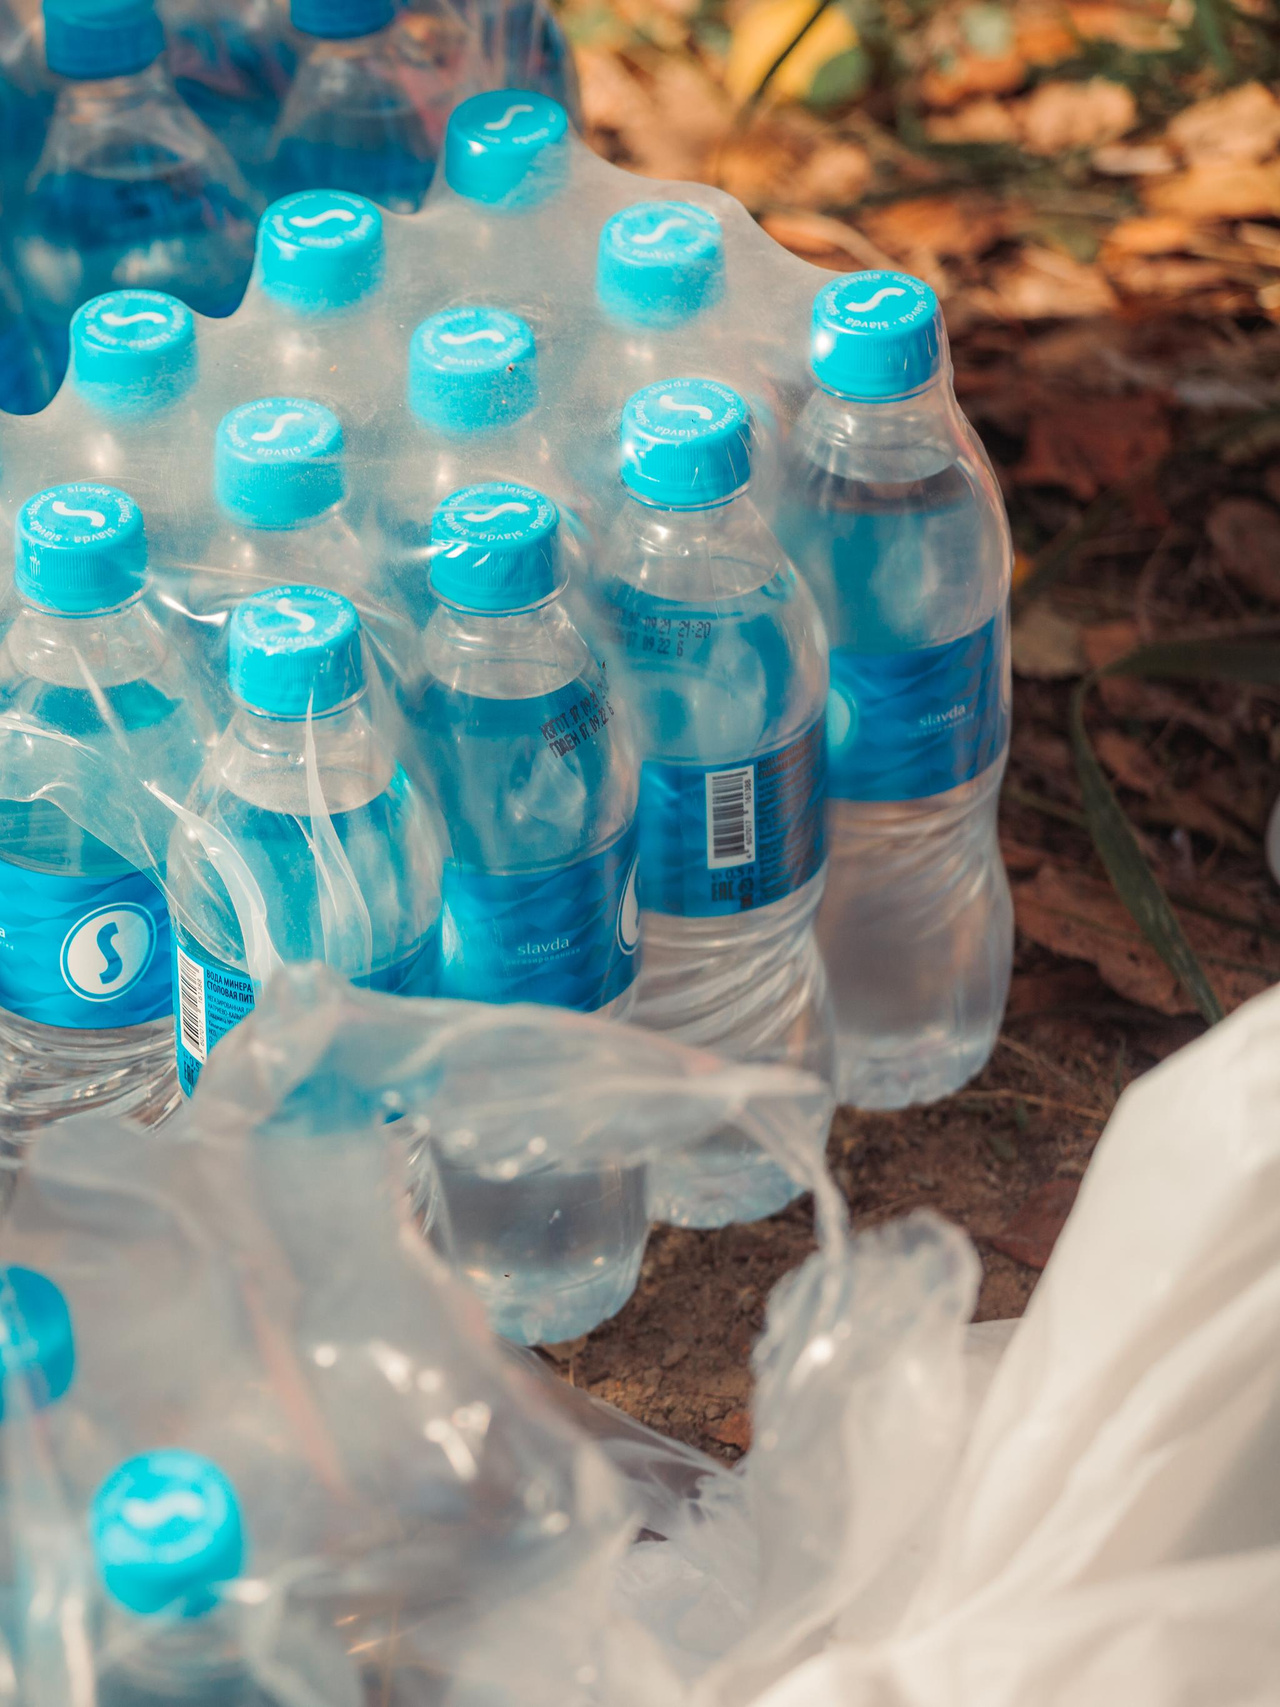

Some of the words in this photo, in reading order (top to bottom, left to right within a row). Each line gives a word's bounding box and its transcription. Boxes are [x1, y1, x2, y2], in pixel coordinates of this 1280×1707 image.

[73, 527, 117, 544] slavda
[478, 530, 524, 543] slavda
[517, 936, 570, 956] slavda
[206, 969, 223, 984] ВОДА
